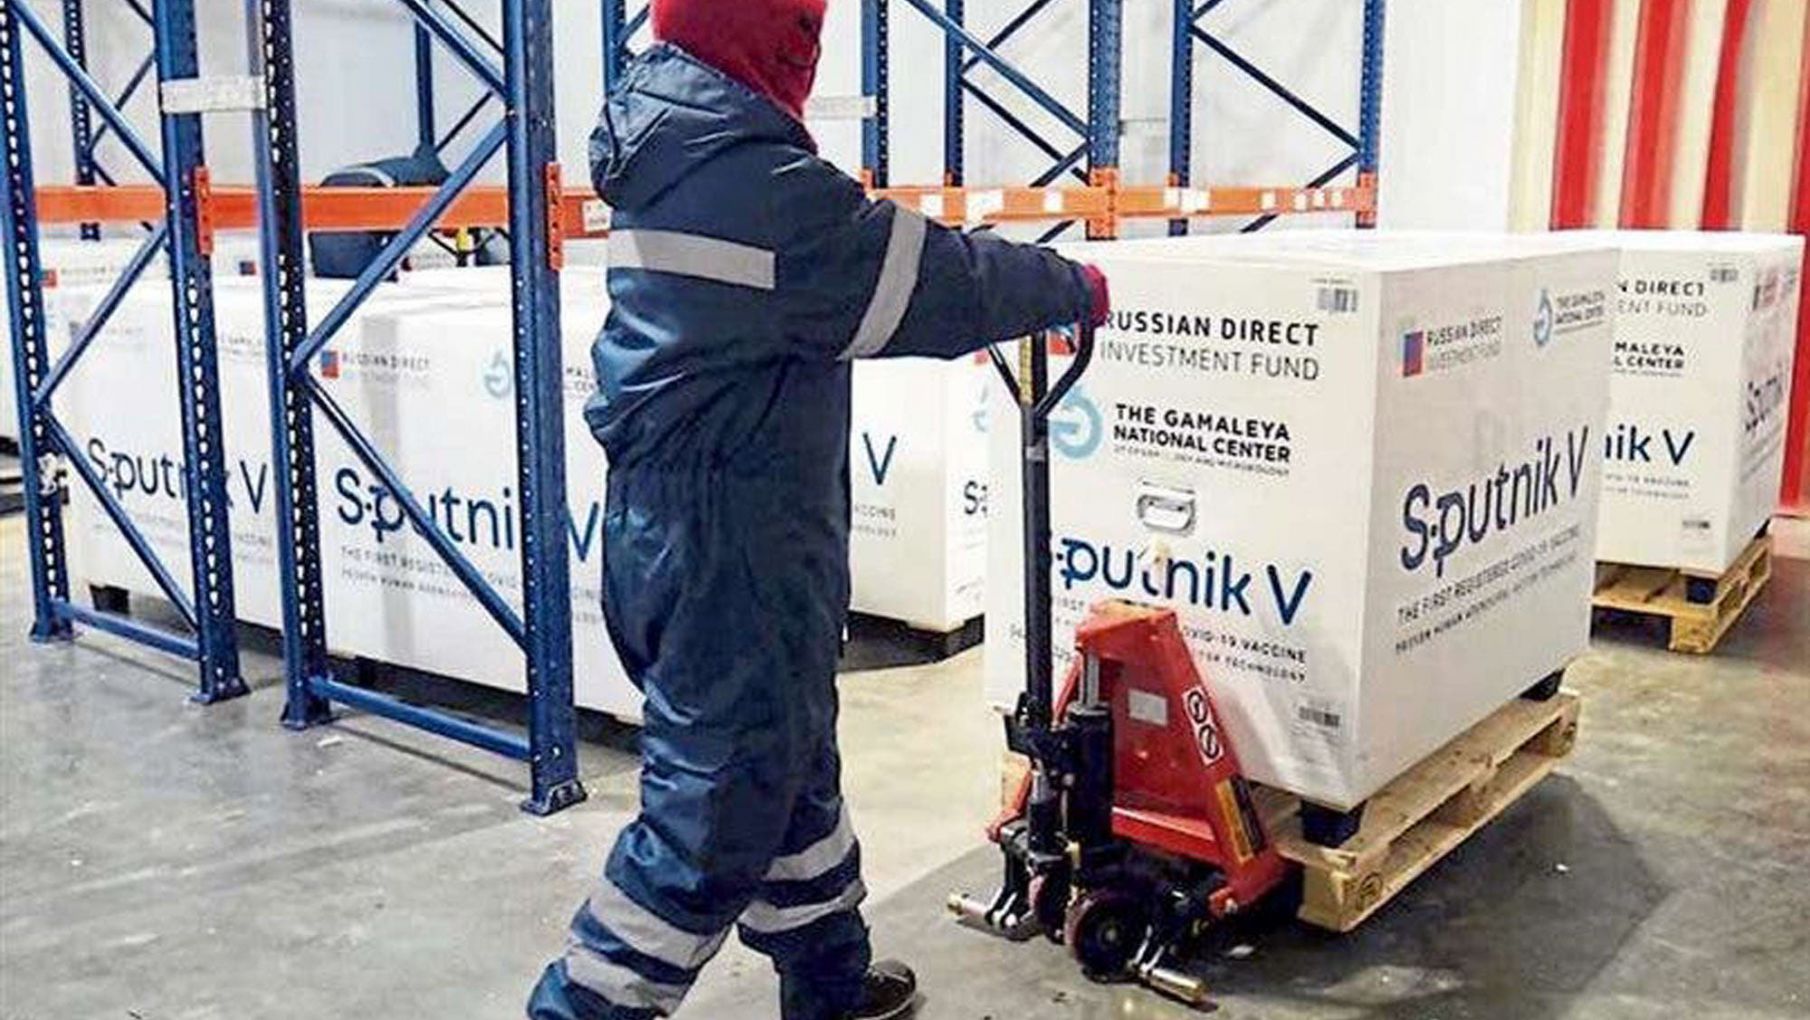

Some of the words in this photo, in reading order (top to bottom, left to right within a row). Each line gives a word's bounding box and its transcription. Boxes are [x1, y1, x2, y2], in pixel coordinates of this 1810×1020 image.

[1635, 280, 1704, 297] DIRECT
[1656, 301, 1707, 317] FUND
[1221, 317, 1319, 347] DIRECT
[1101, 340, 1242, 374] INVESTMENT
[1250, 352, 1319, 382] FUND
[1116, 403, 1157, 425] THE
[1163, 409, 1291, 442] GAMALEYA
[862, 431, 897, 486] V
[1113, 425, 1208, 453] NATIONAL
[1213, 438, 1291, 463] CENTER
[1663, 429, 1694, 466] V
[238, 459, 268, 515] V
[1401, 436, 1561, 578] Sputnik
[1566, 425, 1590, 499] V
[1266, 563, 1314, 626] V
